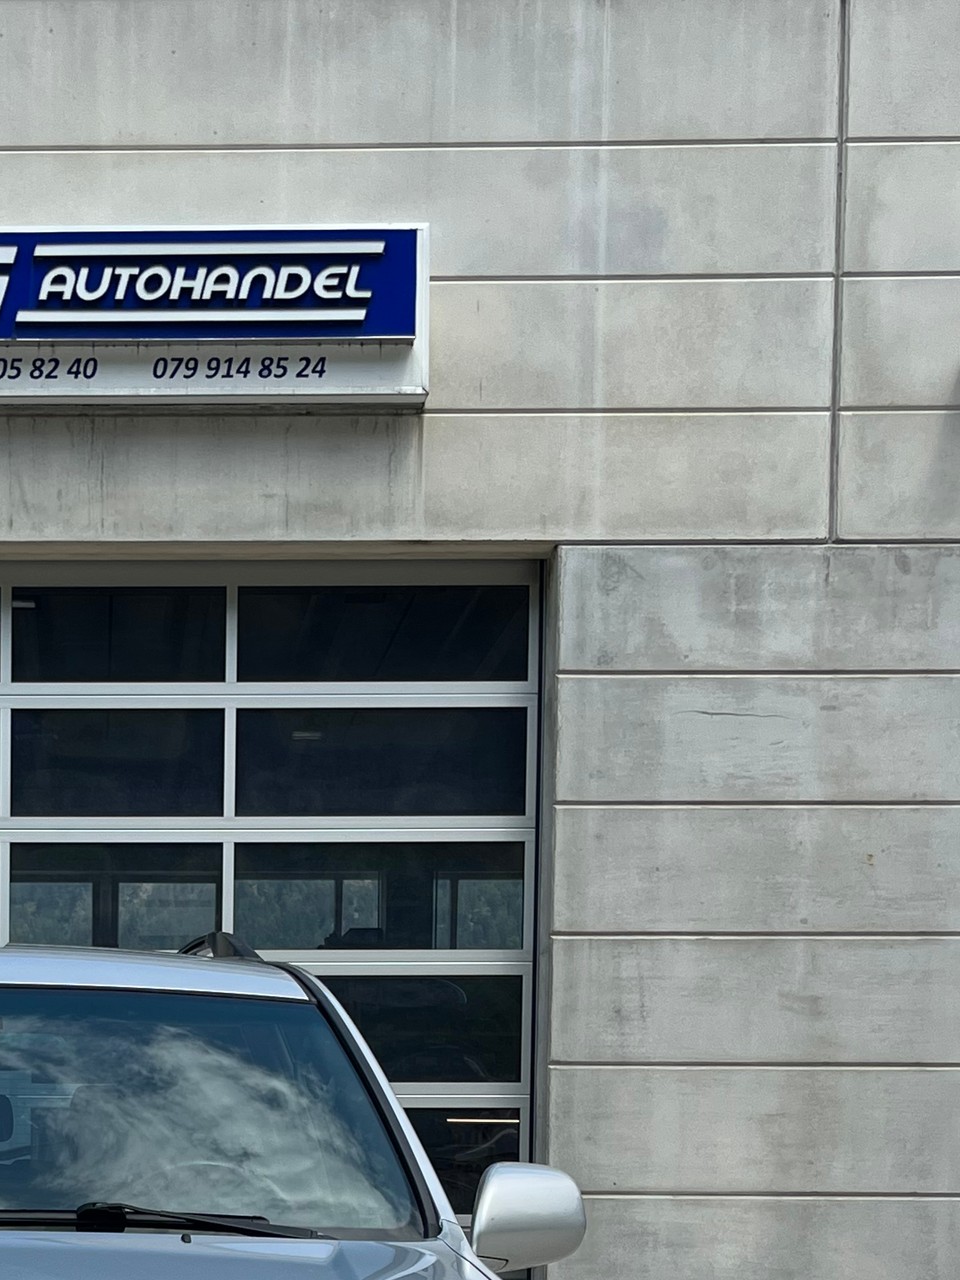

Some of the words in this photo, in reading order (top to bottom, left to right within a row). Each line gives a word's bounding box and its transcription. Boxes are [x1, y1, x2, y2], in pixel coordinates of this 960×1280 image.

[38, 264, 372, 303] AUTOHANDEL
[29, 356, 60, 380] 82
[66, 356, 98, 380] 40
[152, 356, 198, 380] 079
[204, 356, 252, 380] 914
[257, 356, 289, 380] 85
[295, 356, 327, 380] 24
